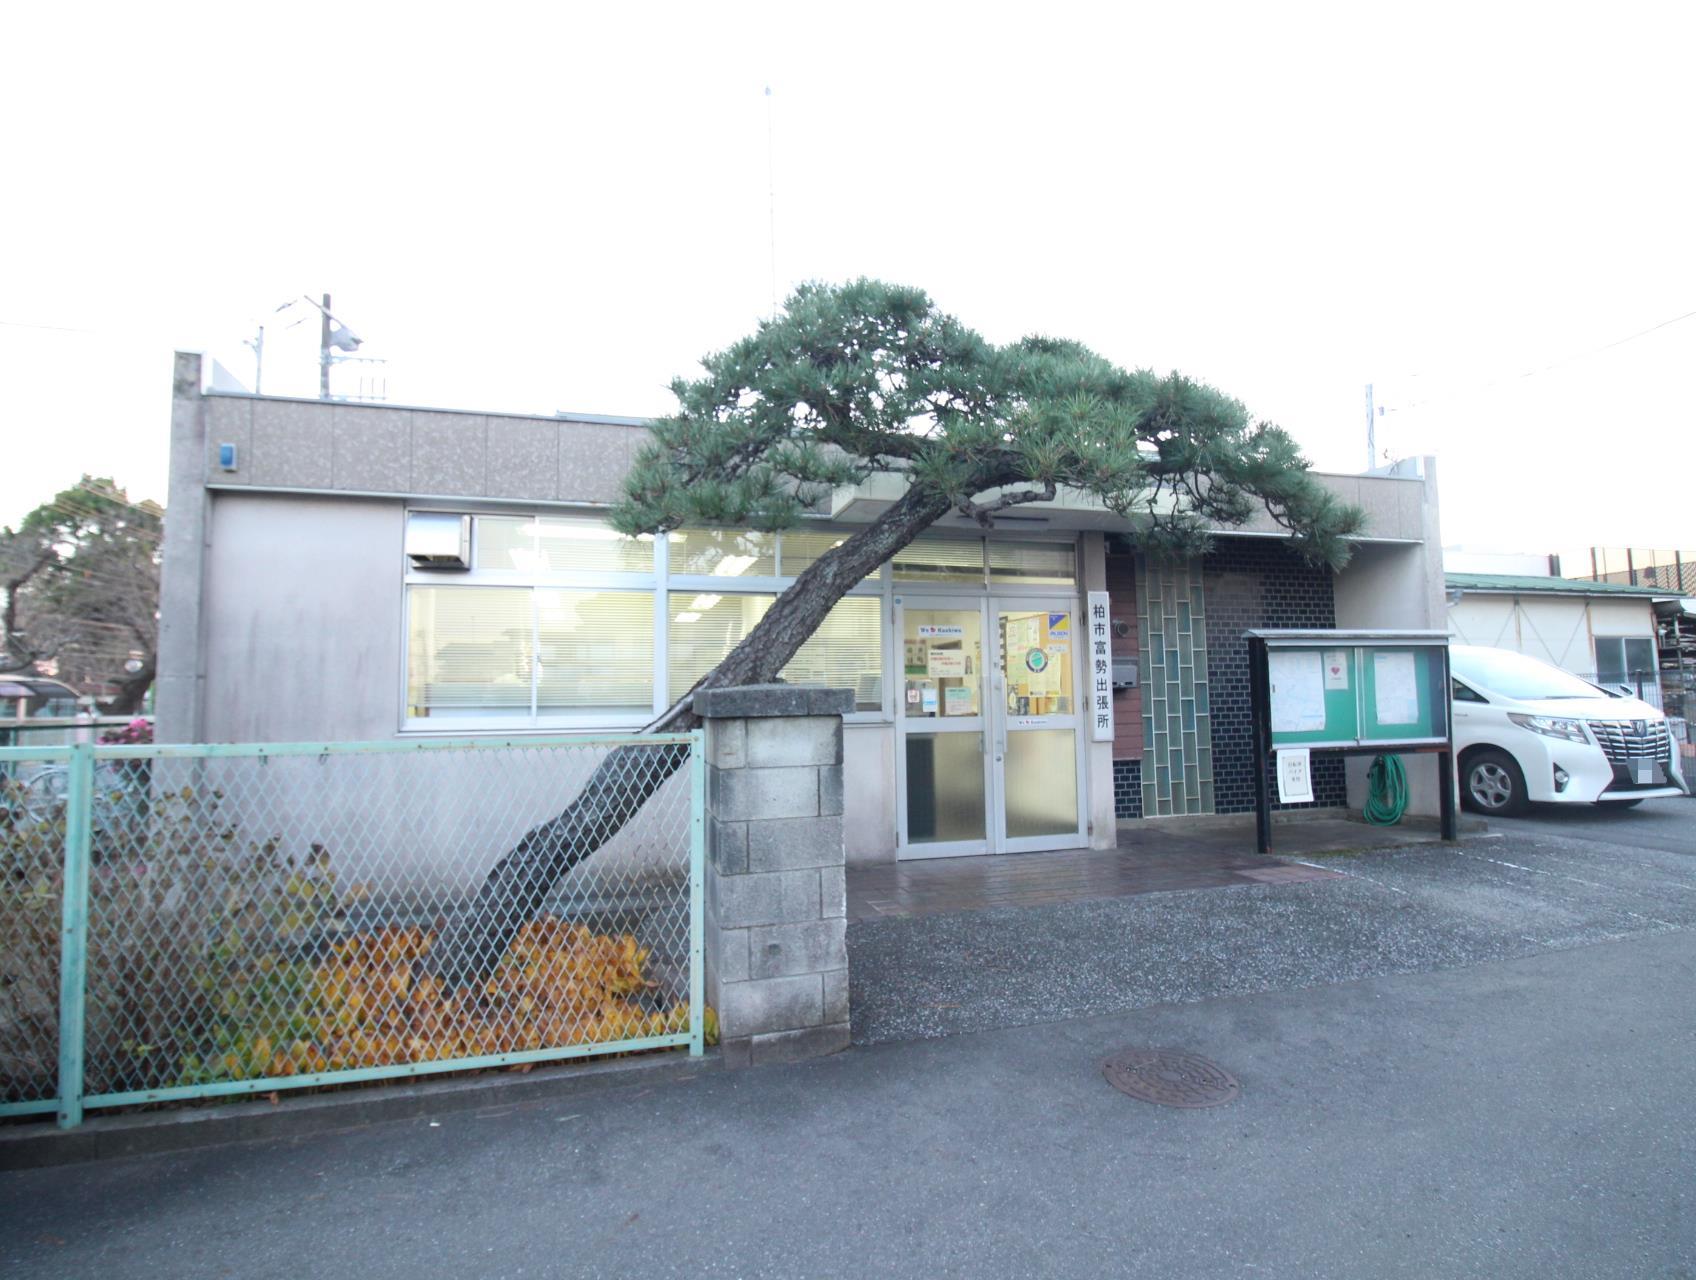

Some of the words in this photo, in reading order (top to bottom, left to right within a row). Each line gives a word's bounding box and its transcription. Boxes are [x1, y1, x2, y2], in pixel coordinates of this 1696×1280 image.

[1093, 604, 1109, 728] 柏市富勢出張所
